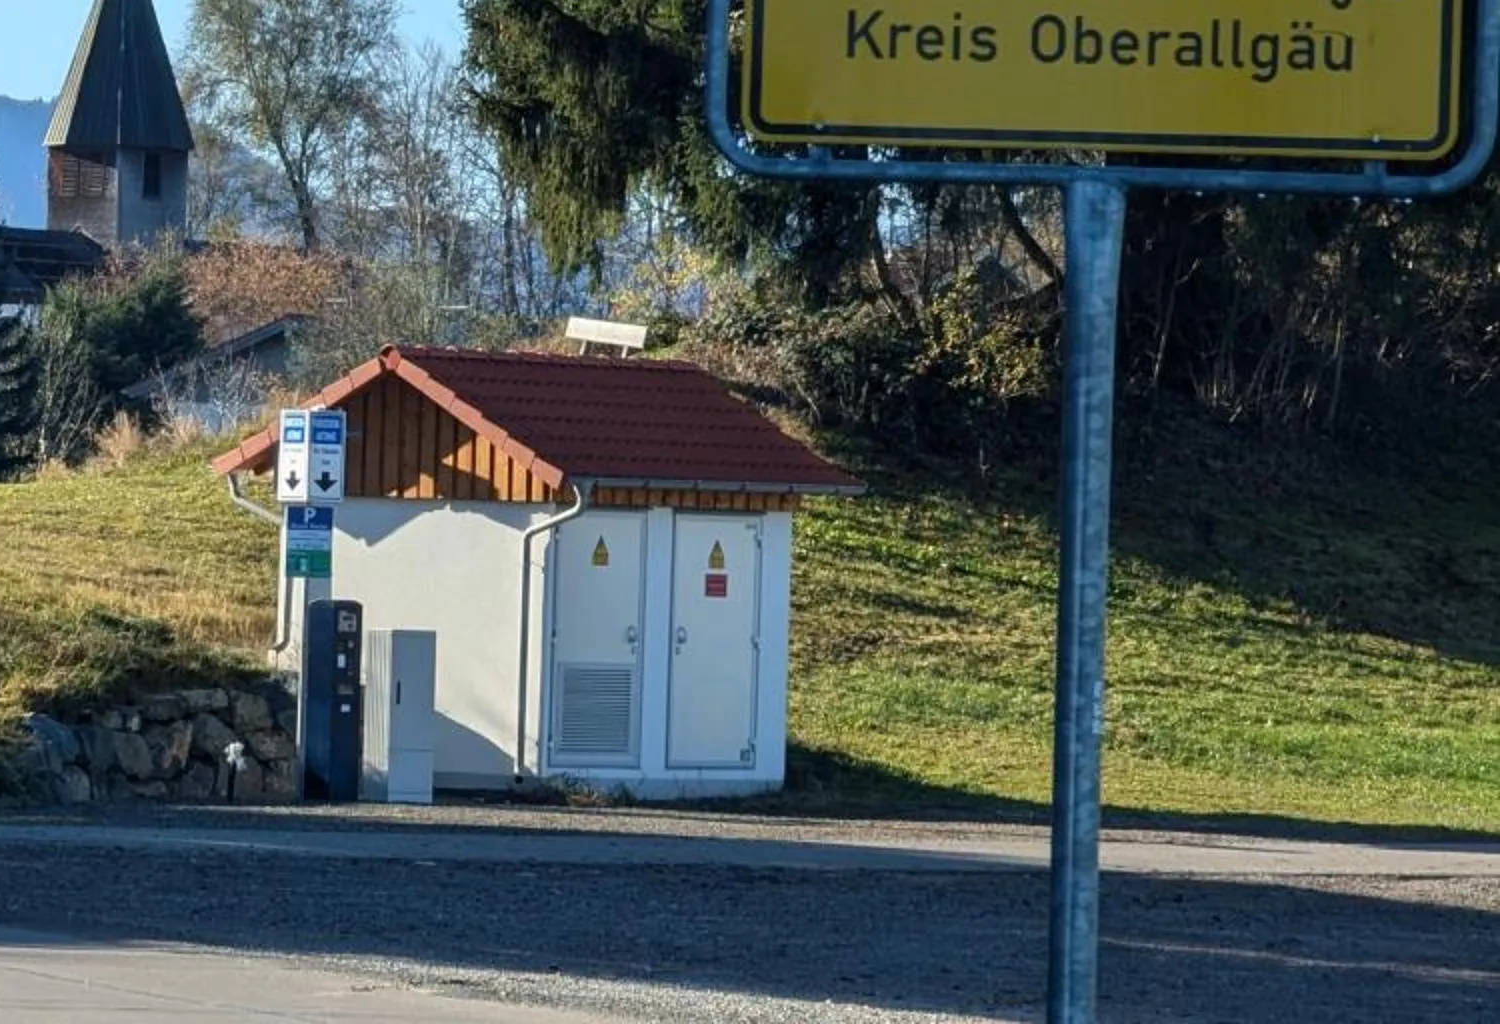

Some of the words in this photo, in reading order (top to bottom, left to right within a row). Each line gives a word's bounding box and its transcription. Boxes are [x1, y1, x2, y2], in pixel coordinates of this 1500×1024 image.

[846, 10, 998, 63] Kreis
[1031, 14, 1354, 84] Oberallgäu
[303, 507, 317, 524] P
